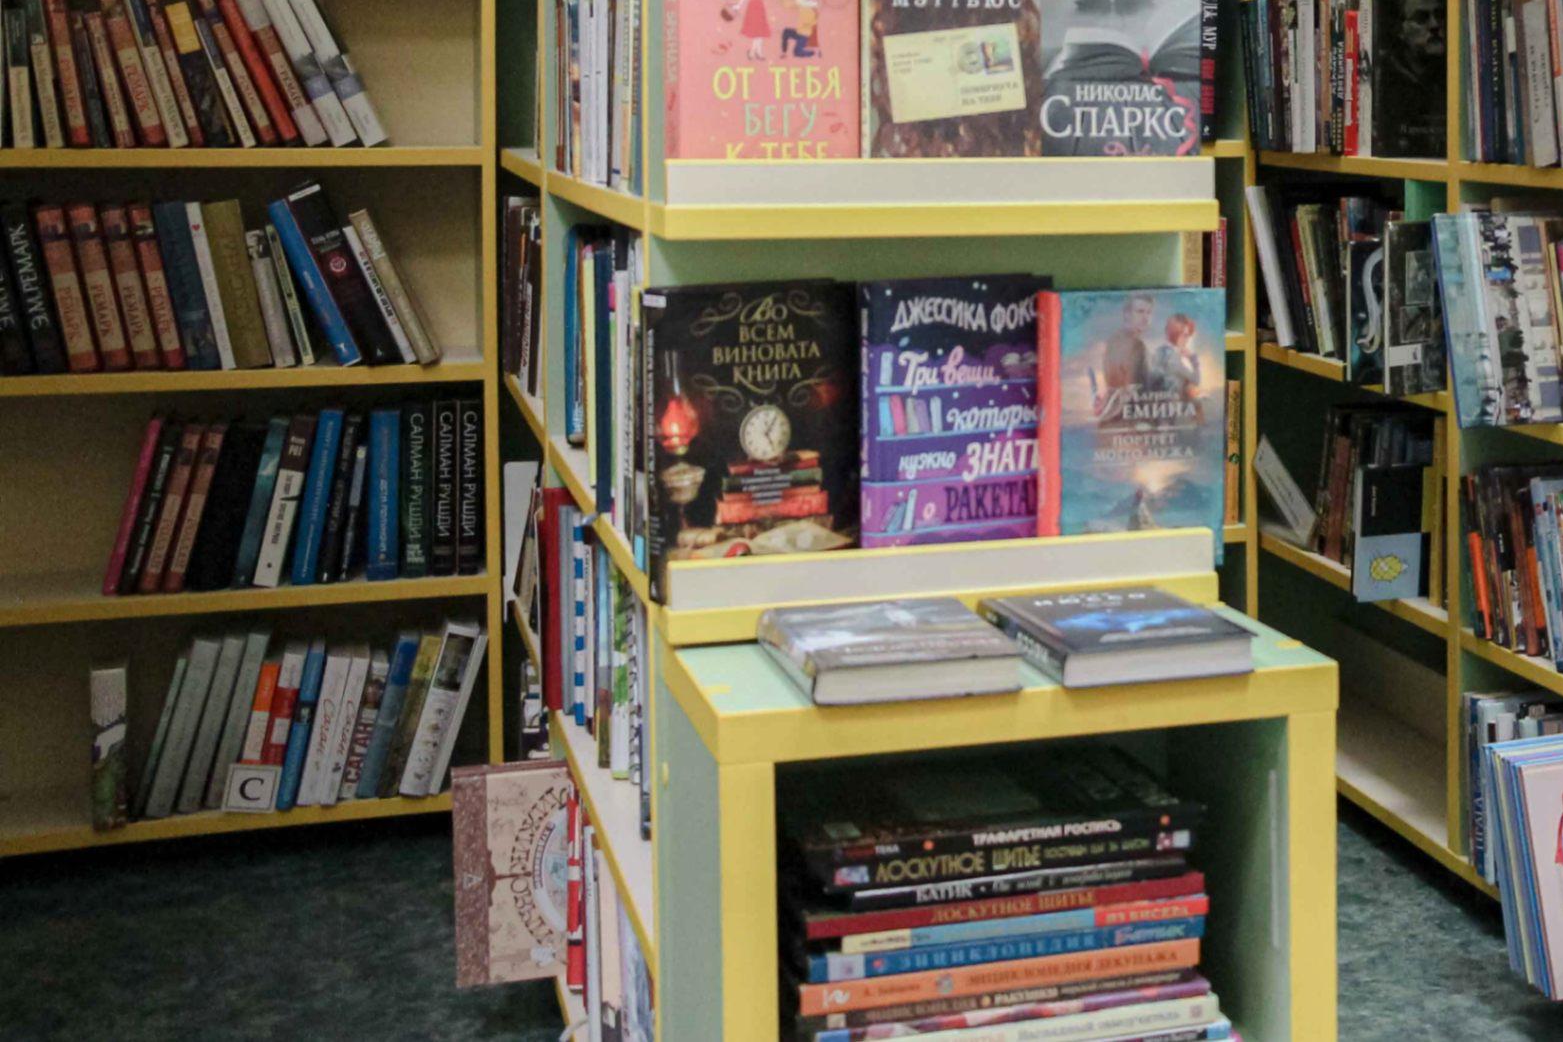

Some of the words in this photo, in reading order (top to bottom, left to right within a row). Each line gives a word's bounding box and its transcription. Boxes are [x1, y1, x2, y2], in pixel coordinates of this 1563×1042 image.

[713, 65, 752, 100] ОТ
[771, 65, 842, 100] ТЕБЯ
[1075, 84, 1163, 103] НИКОЛАС
[743, 102, 819, 138] БЕГУ
[891, 296, 987, 334] ДЖЕССИКА
[737, 322, 795, 345] ВСЕМ
[712, 342, 820, 365] ВИНОВАТА
[898, 351, 939, 388] Три
[732, 361, 802, 385] КНИГА
[1086, 389, 1197, 419] ДЕМИНА
[410, 413, 424, 481] САЛМАН
[439, 412, 453, 479] САЛМАН
[463, 411, 478, 478] САЛМАН
[1113, 432, 1176, 447] ПОРТРЕТ
[899, 451, 955, 471] нужно
[411, 486, 425, 544] РУШДИ
[438, 483, 451, 537] РУШДИ
[462, 482, 476, 536] РУШДИ
[239, 778, 264, 801] С
[875, 850, 985, 883] ЛОСКУТНОЕ
